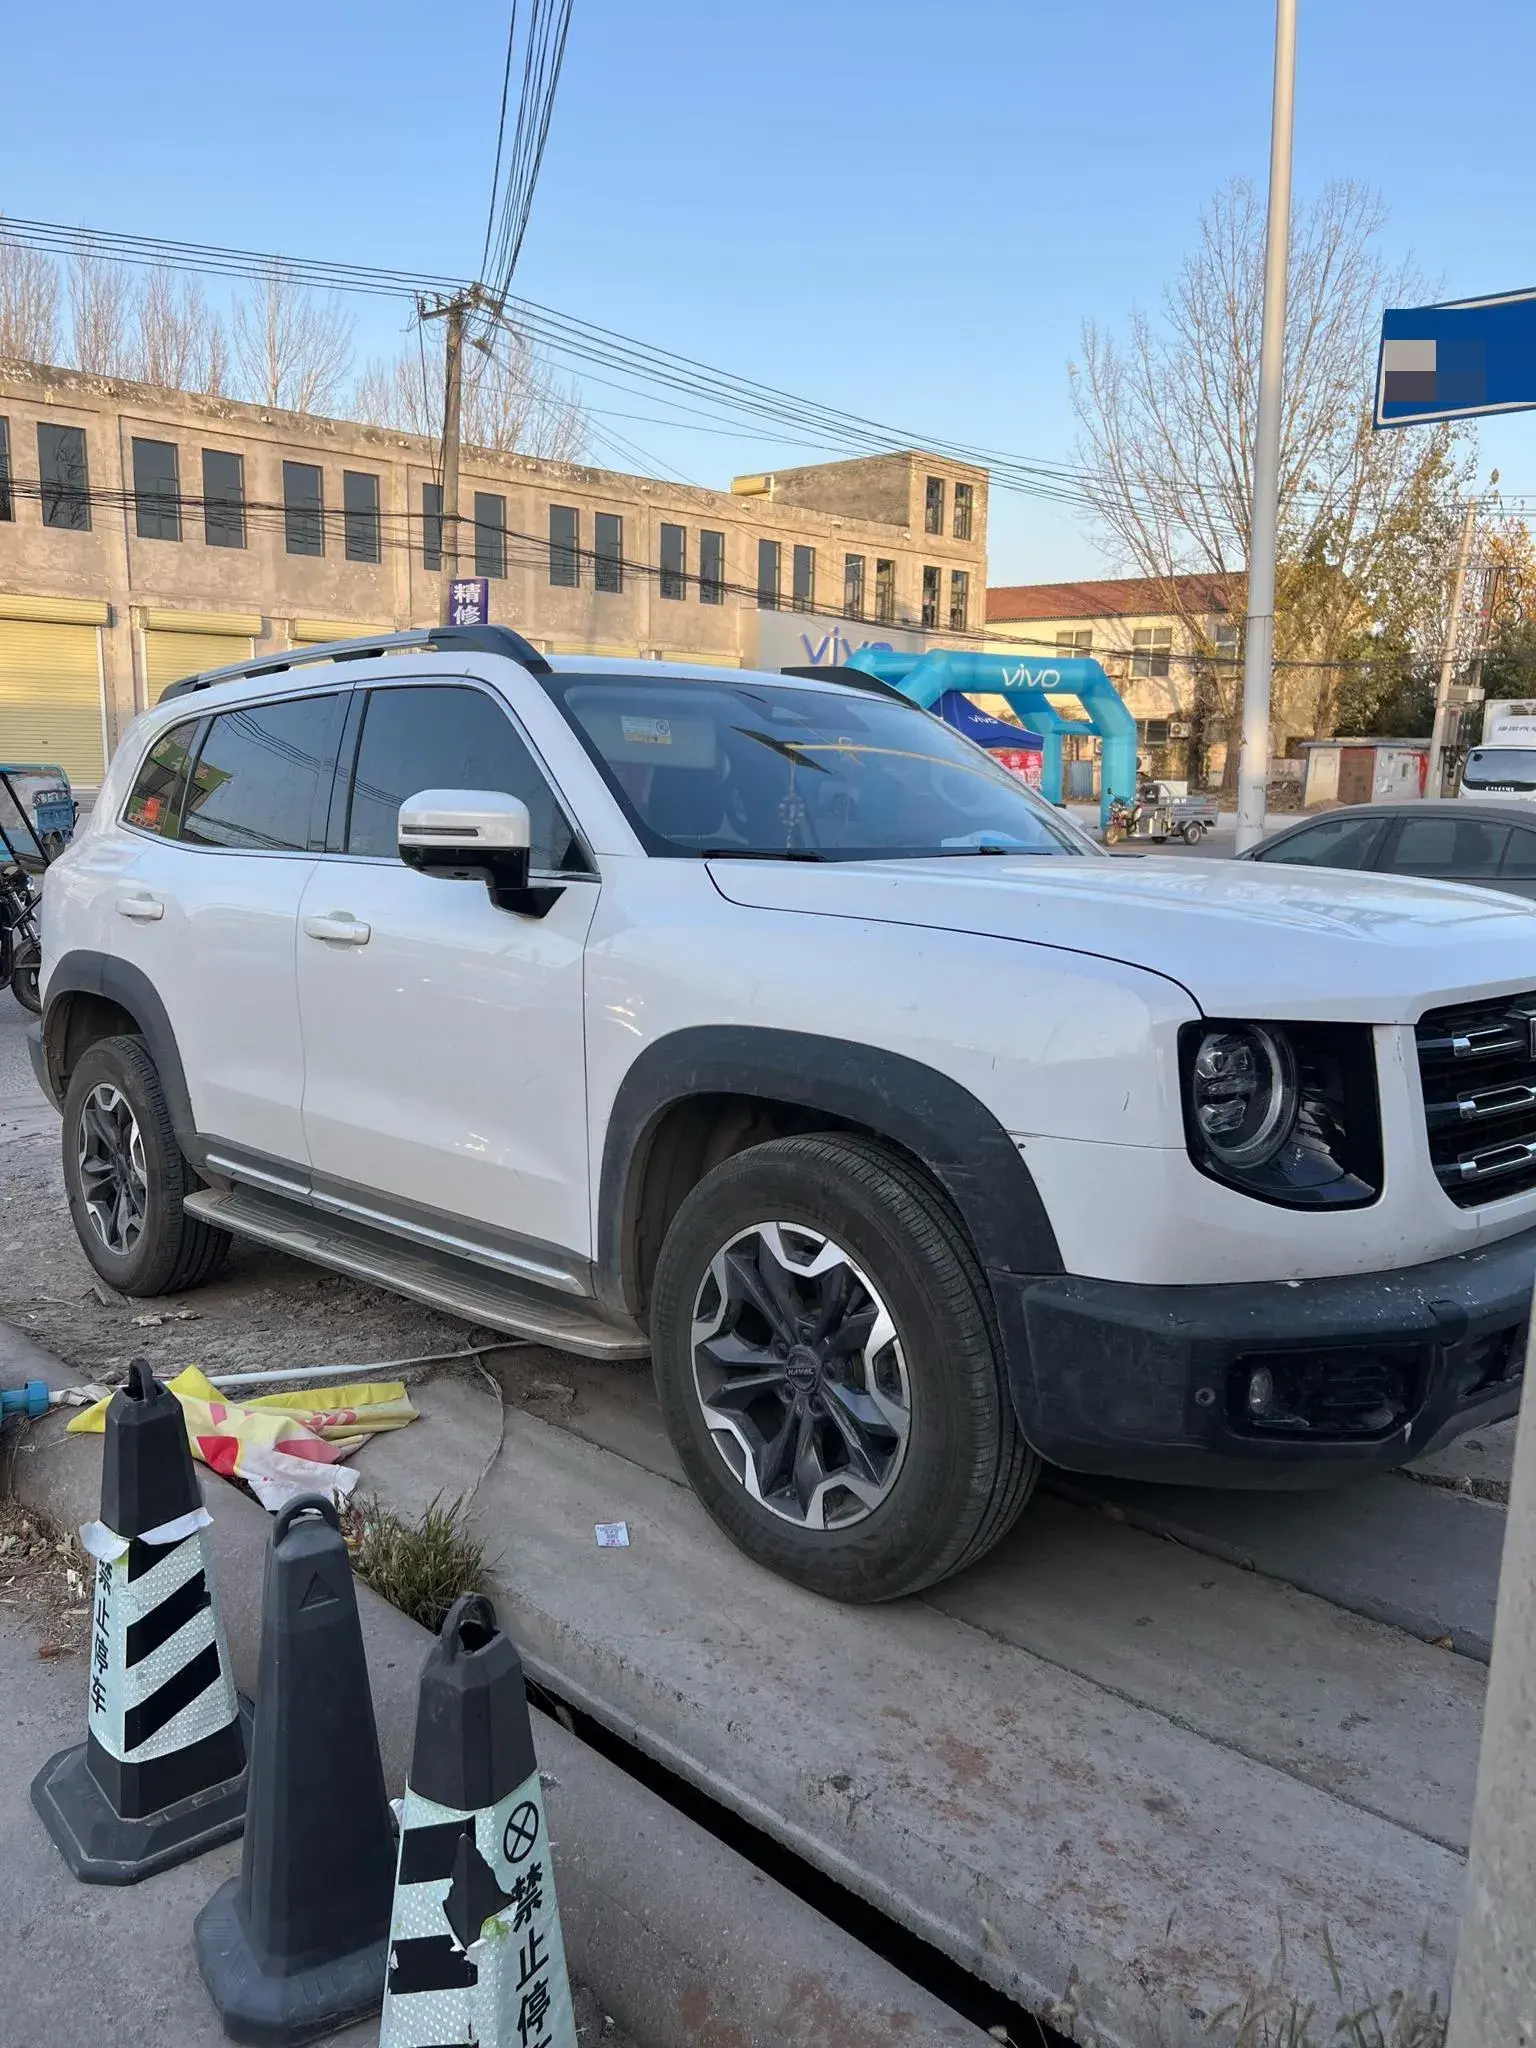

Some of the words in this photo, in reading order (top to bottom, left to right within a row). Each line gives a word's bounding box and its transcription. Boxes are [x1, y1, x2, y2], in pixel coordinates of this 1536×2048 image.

[453, 583, 481, 625] 精修
[1001, 663, 1060, 688] vivo
[968, 714, 999, 724] vivo
[510, 1860, 554, 2048] 禁止停
